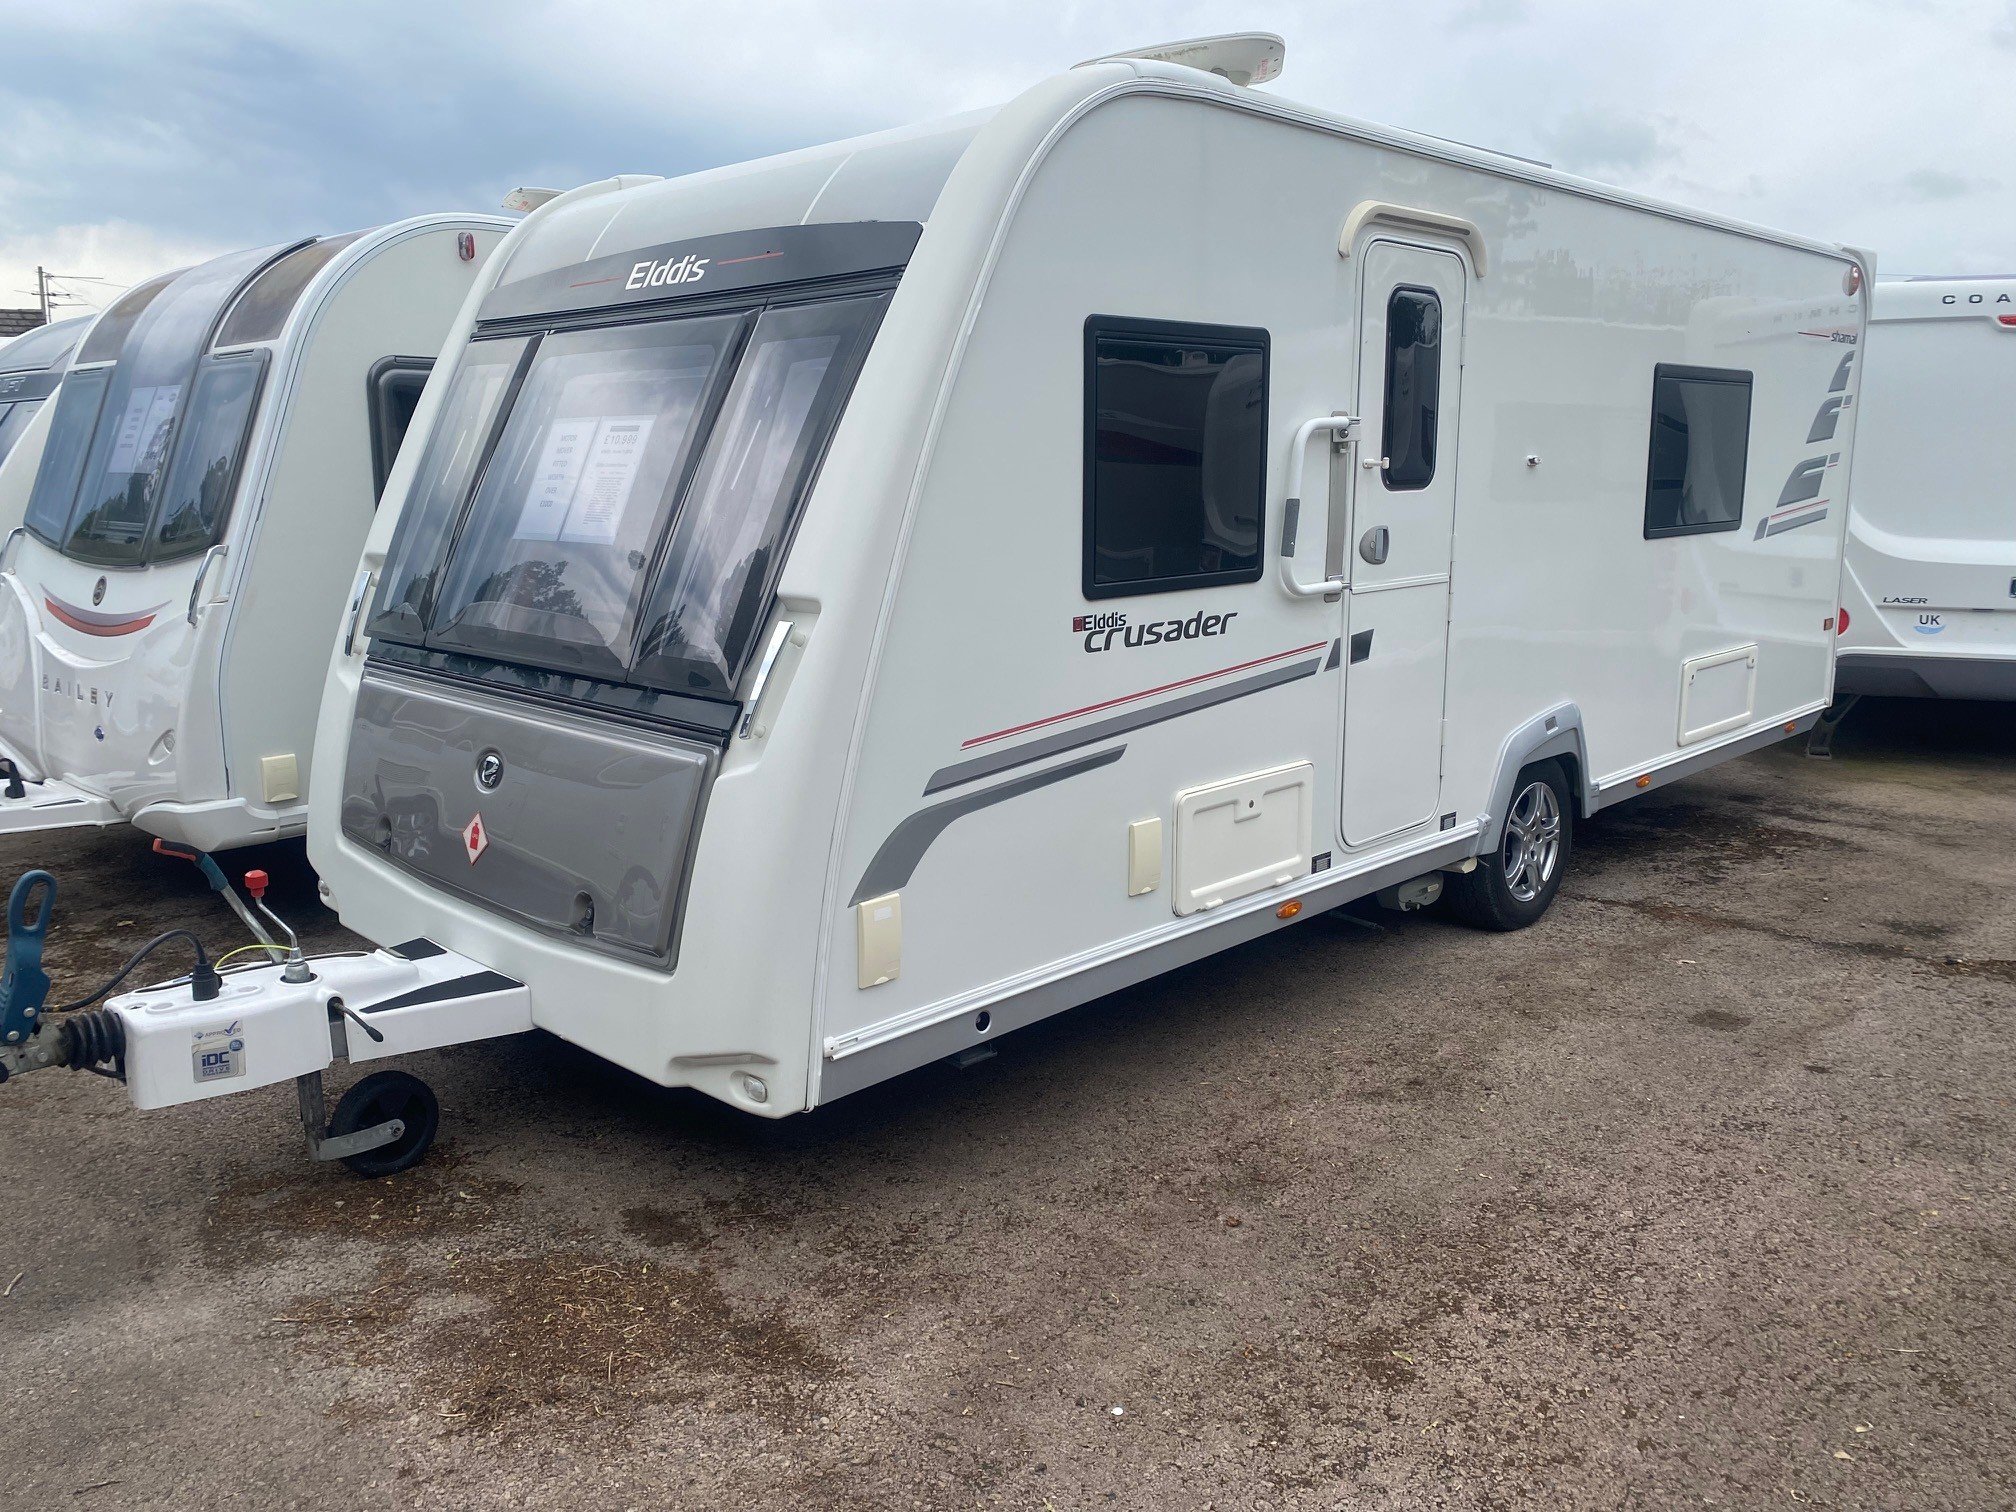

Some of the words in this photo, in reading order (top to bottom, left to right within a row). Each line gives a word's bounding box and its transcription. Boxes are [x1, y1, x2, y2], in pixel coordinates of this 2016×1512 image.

[624, 254, 711, 290] Elddis
[1942, 293, 2011, 304] COA
[1831, 331, 1858, 345] shamal
[1083, 611, 1127, 631] Elddis
[1919, 615, 1940, 625] UK
[1084, 611, 1238, 653] crusader
[42, 674, 114, 708] BAILEY
